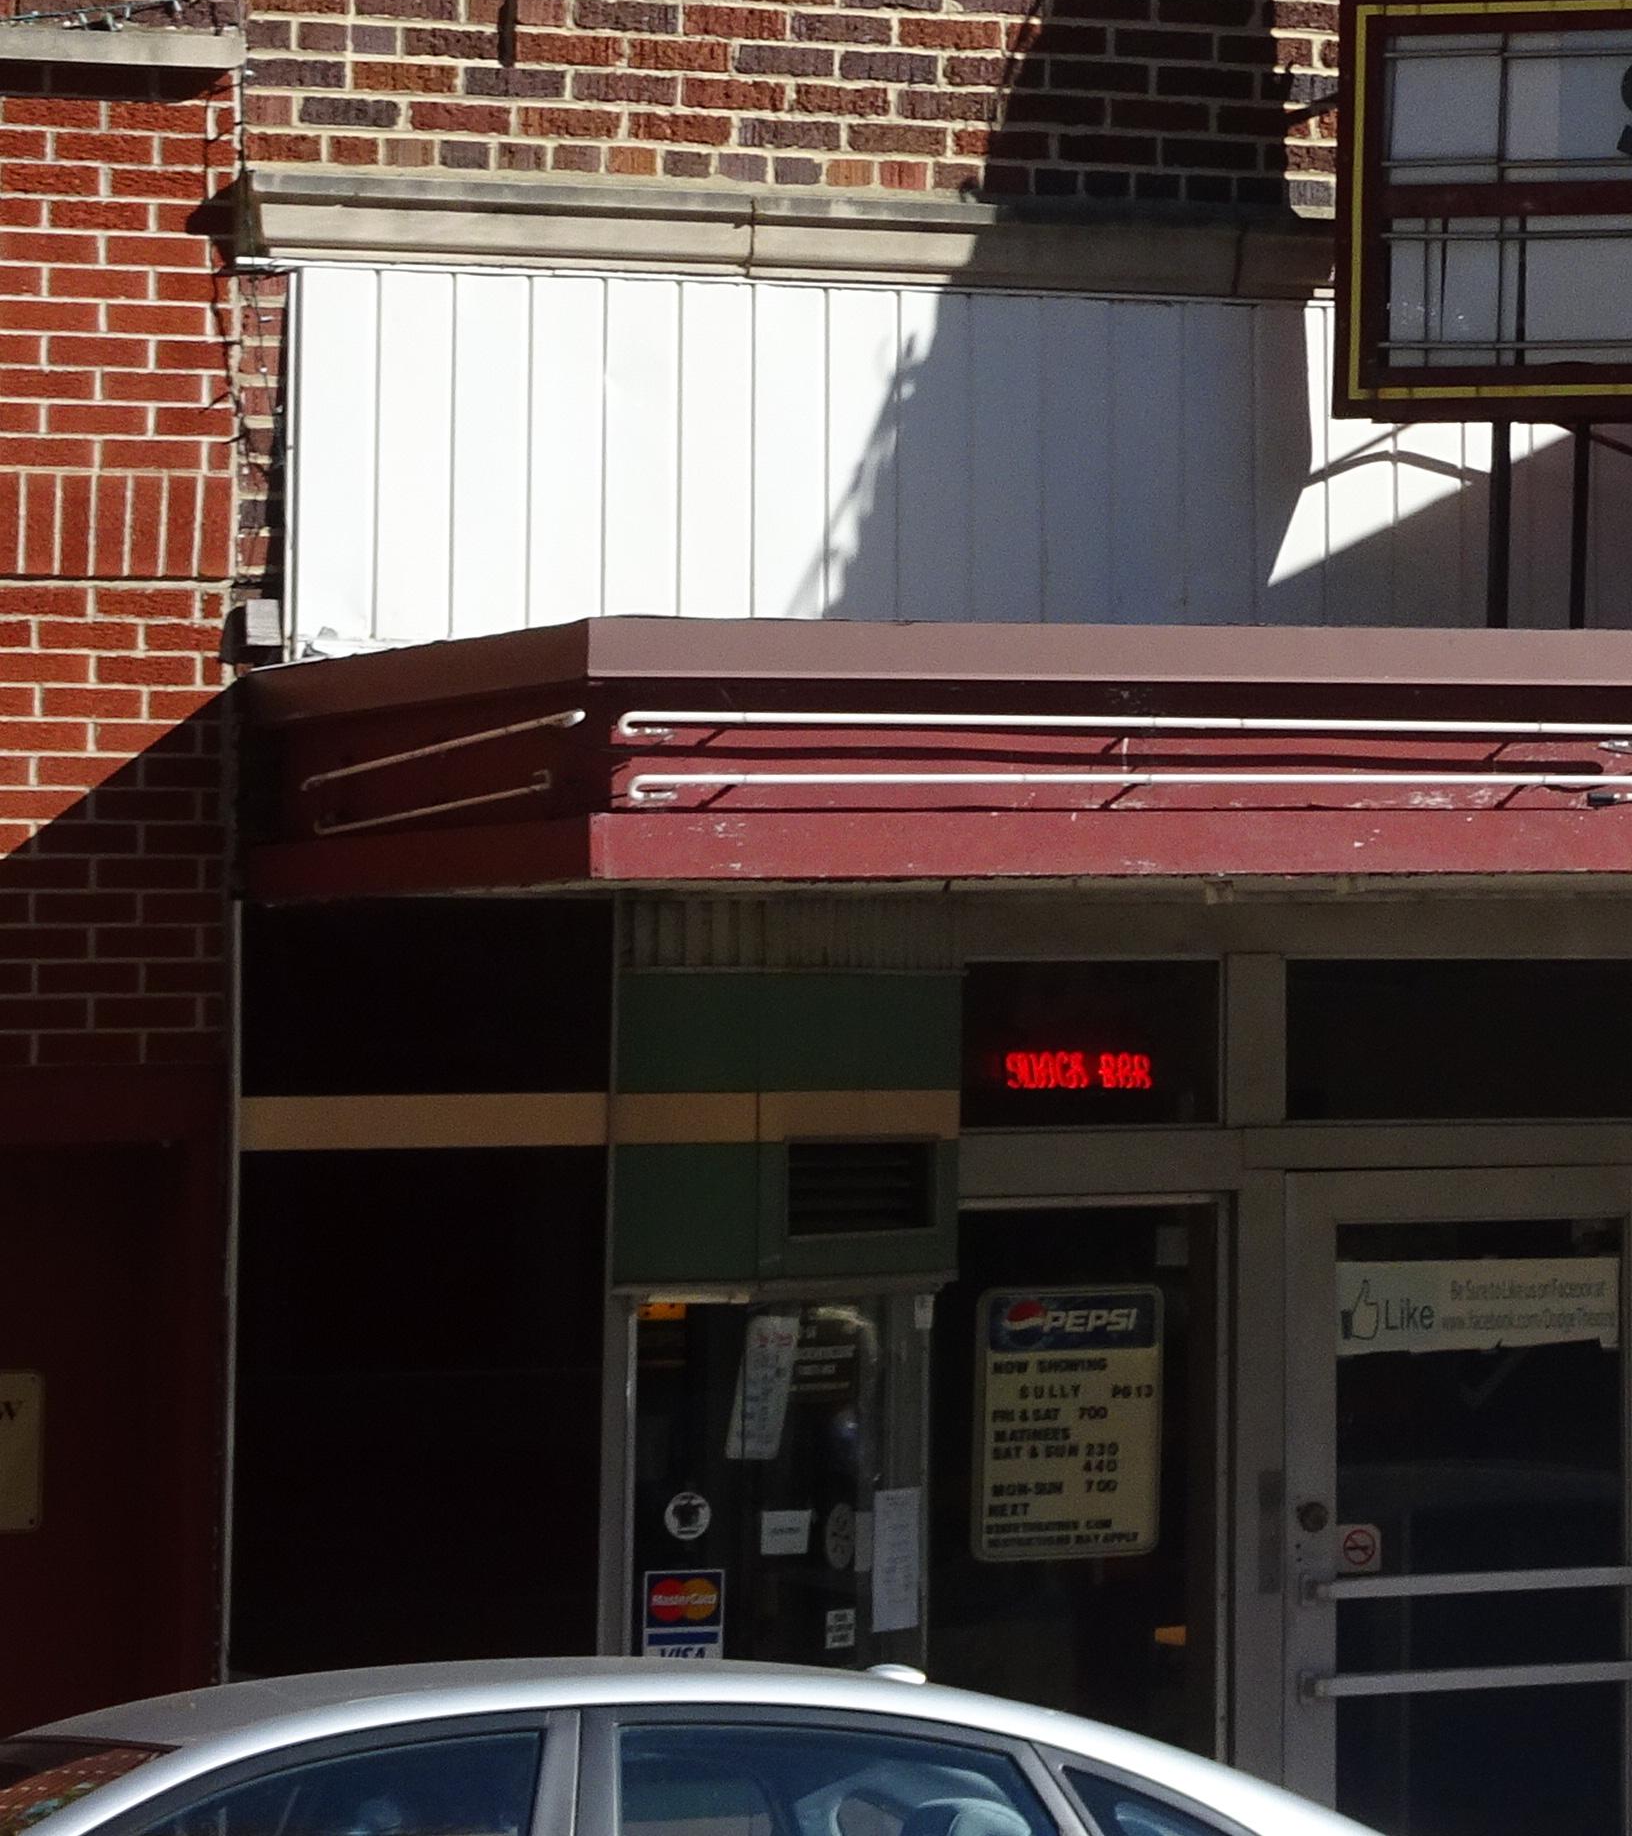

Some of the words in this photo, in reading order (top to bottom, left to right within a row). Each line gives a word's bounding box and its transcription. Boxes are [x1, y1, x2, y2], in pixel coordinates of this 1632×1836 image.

[1040, 1308, 1138, 1334] PEPSI
[1385, 1298, 1434, 1331] Like
[1019, 1384, 1081, 1400] SULLY
[1079, 1406, 1108, 1420] 700
